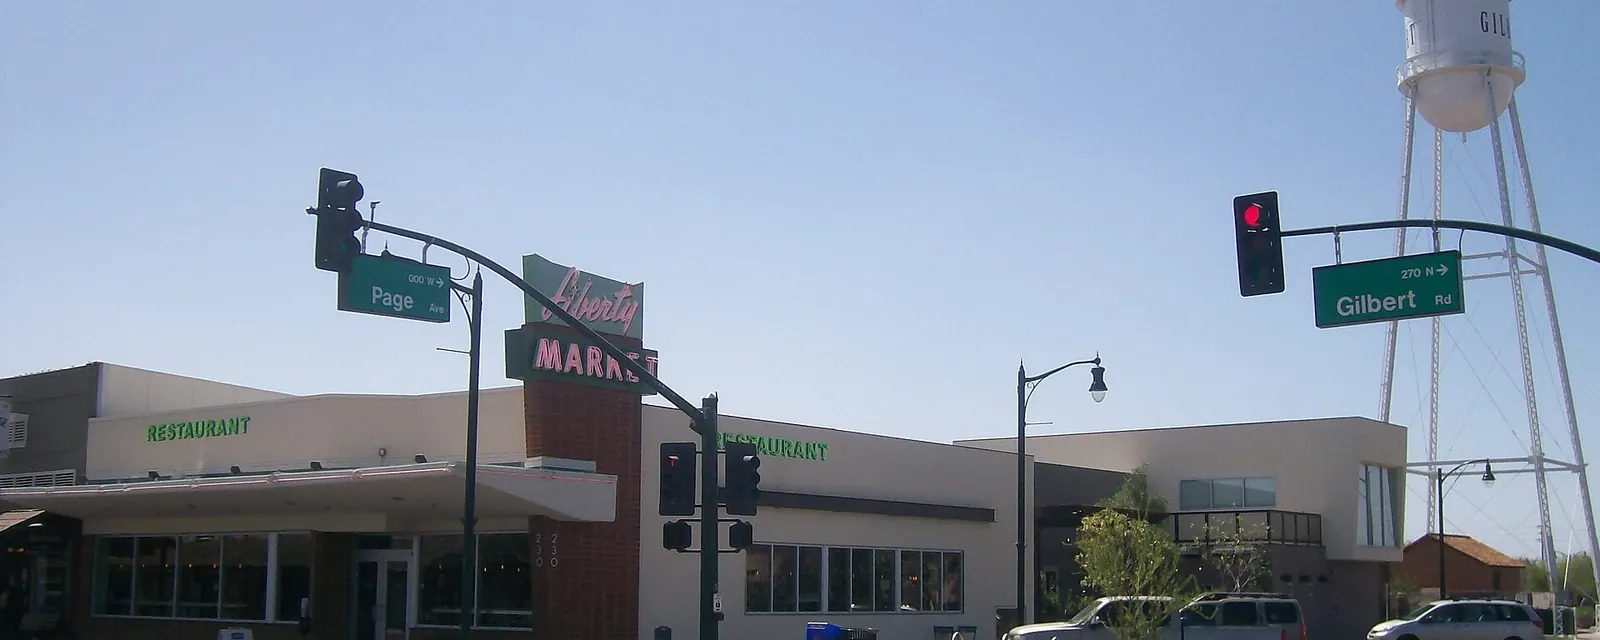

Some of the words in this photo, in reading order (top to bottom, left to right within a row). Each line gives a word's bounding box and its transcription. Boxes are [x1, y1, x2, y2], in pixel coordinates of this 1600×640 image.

[408, 273, 425, 285] 000
[427, 278, 434, 286] W
[1401, 267, 1421, 279] 270
[1425, 267, 1434, 276] N
[372, 285, 414, 312] Page
[541, 267, 638, 335] Liberty
[1336, 289, 1417, 317] Gilbert
[1434, 294, 1452, 306] Rd
[429, 303, 445, 314] Ave
[145, 416, 250, 442] RESTAURANT
